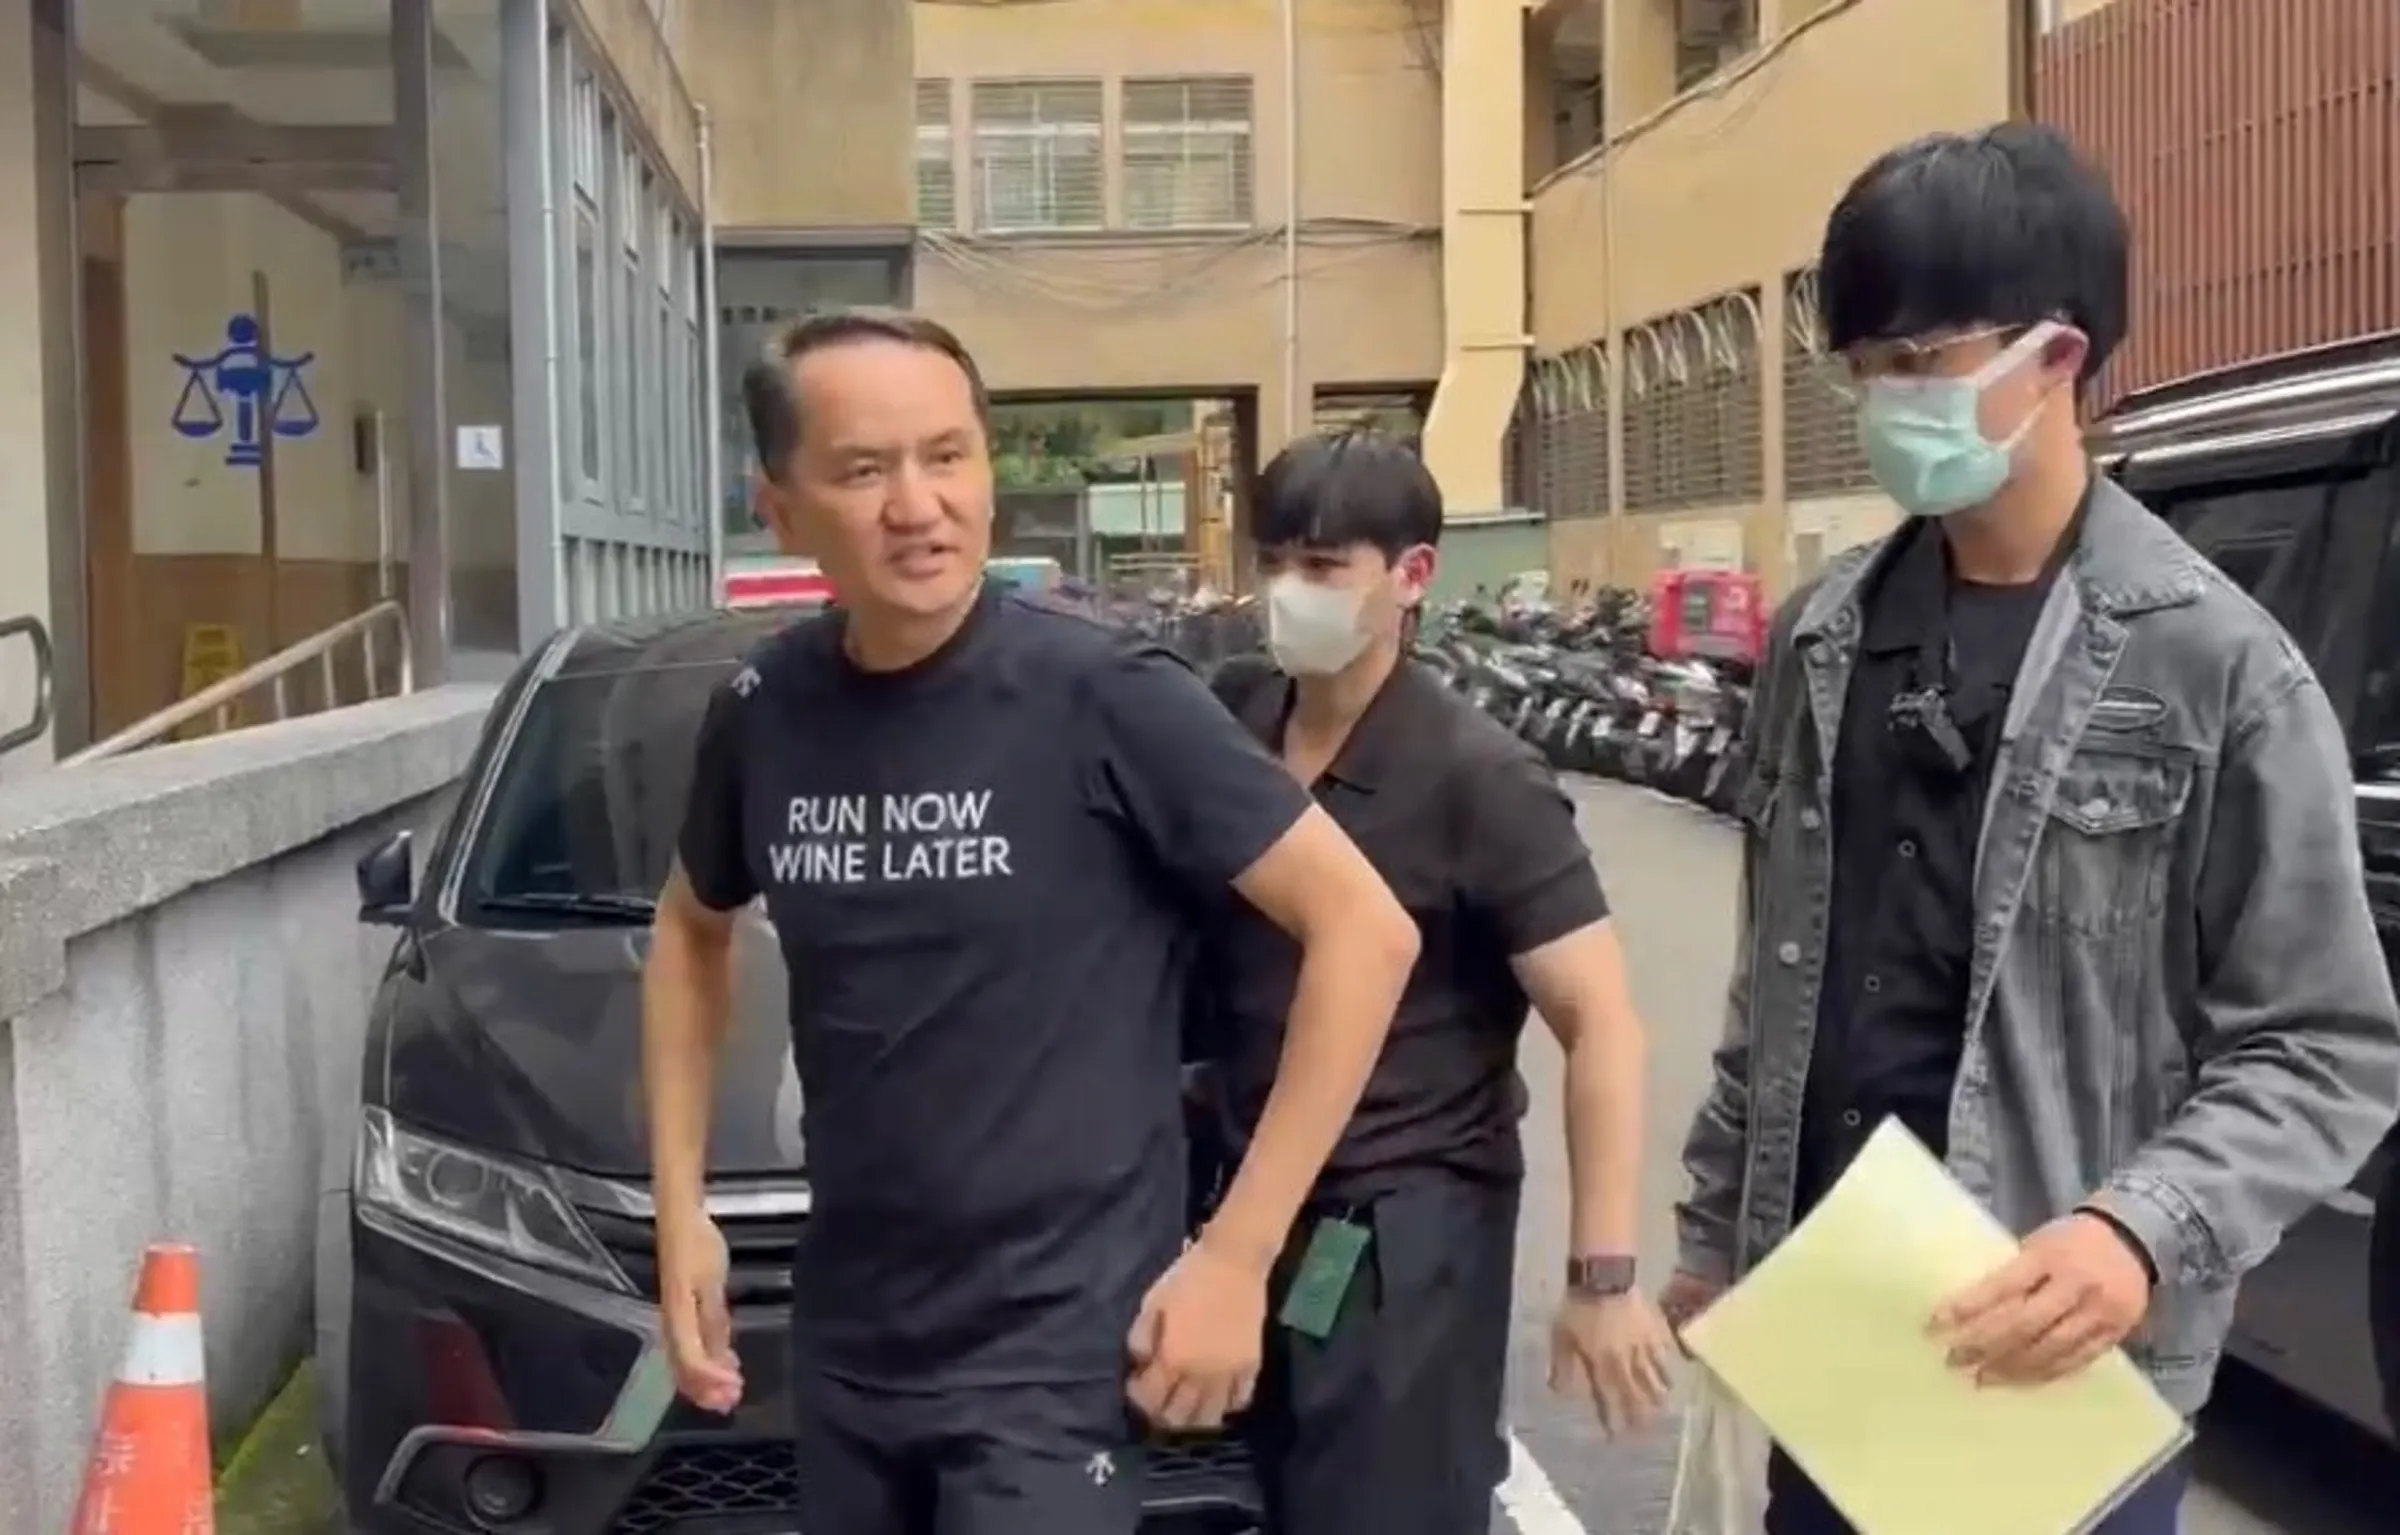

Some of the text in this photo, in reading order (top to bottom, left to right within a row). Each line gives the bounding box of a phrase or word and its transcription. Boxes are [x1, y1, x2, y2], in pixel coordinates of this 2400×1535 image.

[788, 789, 992, 834] RUN NOW
[769, 836, 1014, 882] WINE LATER
